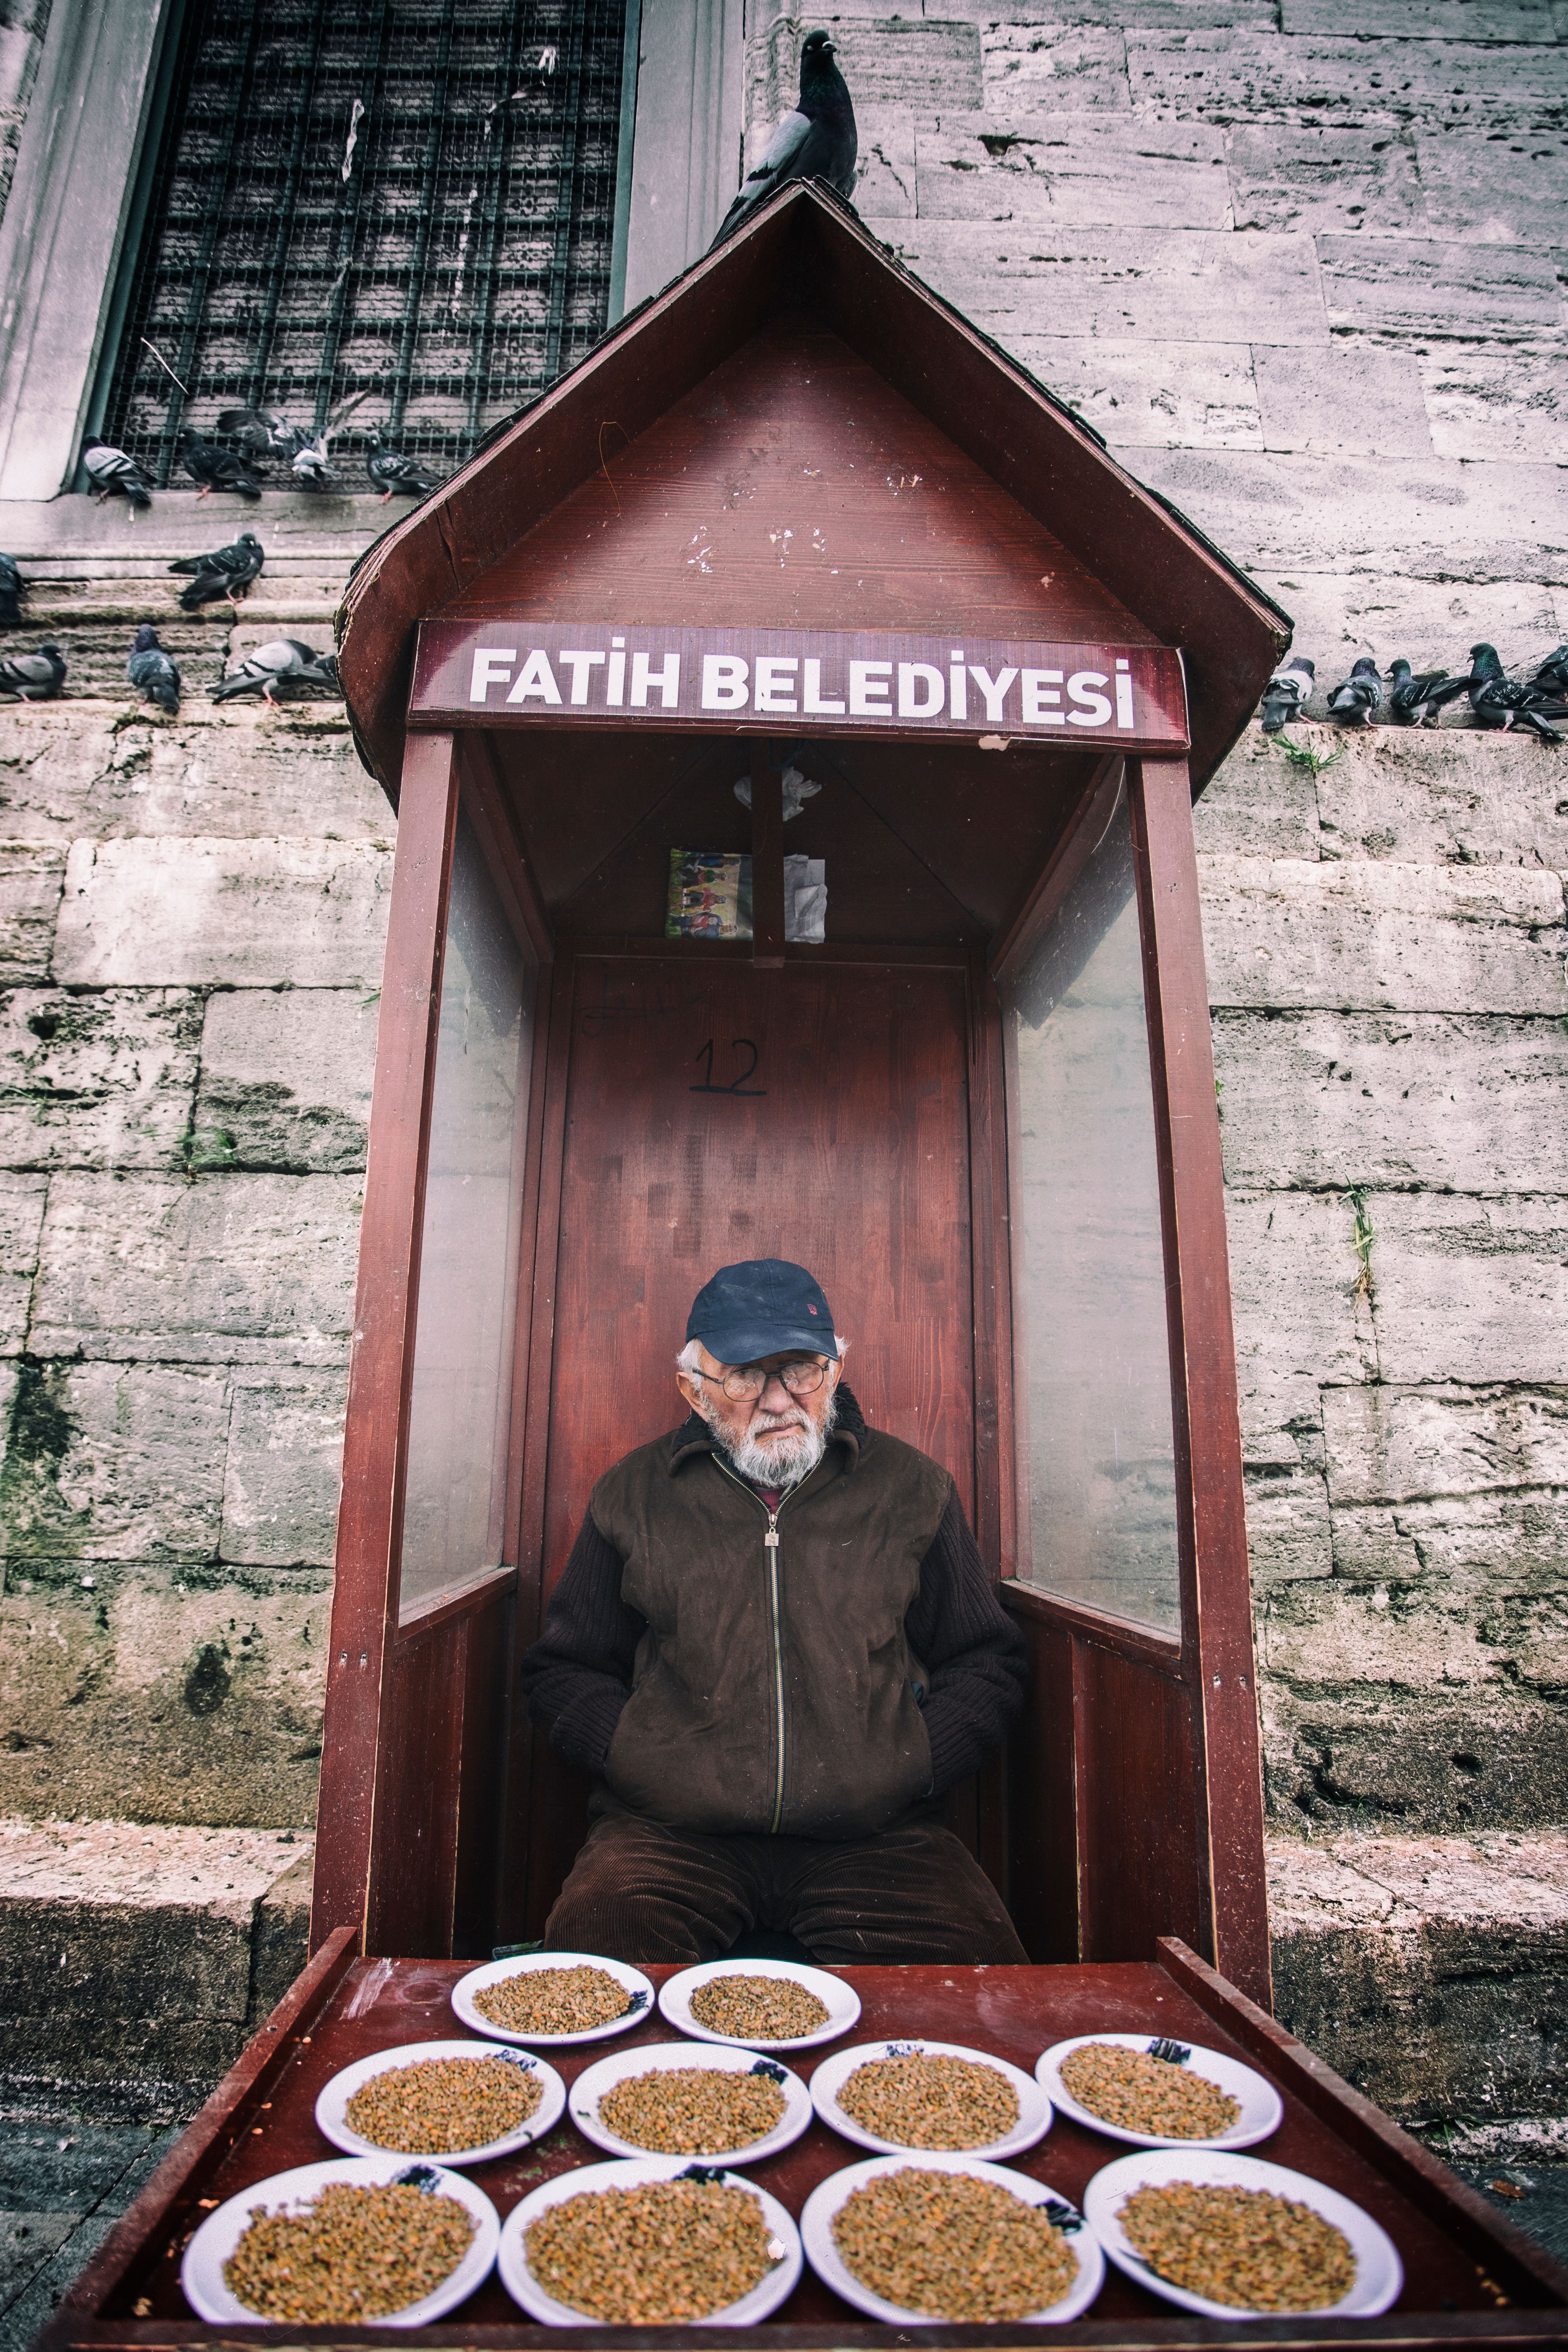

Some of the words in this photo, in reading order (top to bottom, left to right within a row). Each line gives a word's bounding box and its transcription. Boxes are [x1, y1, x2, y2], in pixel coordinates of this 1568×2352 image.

[469, 636, 680, 708] FATİH
[701, 650, 1134, 728] BELEDİYESİ
[689, 1038, 767, 1097] 12
